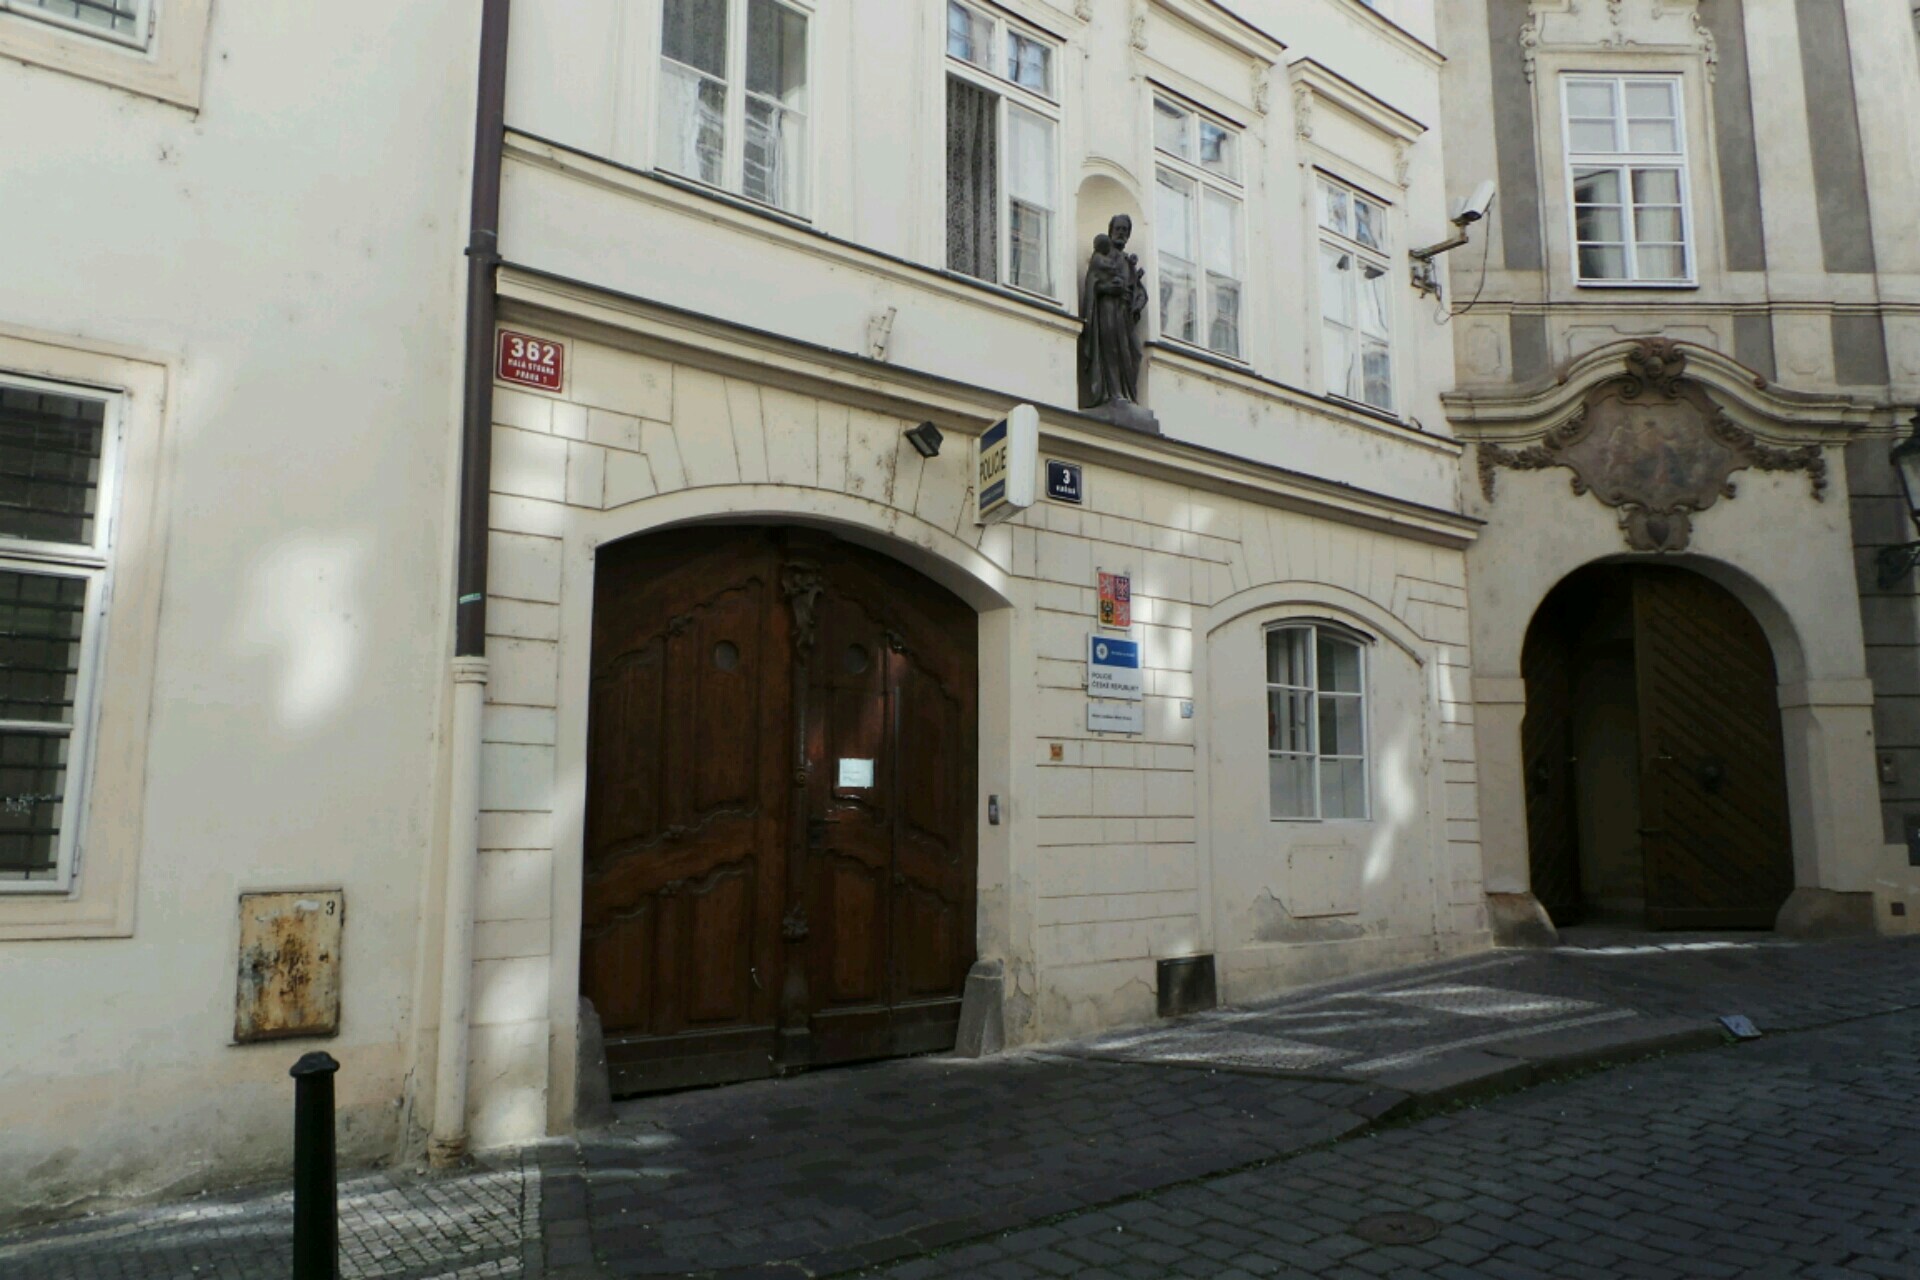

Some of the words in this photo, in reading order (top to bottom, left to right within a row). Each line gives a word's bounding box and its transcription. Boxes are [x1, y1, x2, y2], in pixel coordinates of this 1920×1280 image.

[511, 337, 554, 366] 362
[516, 369, 539, 382] PRAHA
[1063, 469, 1070, 484] 3
[326, 901, 335, 916] 3
